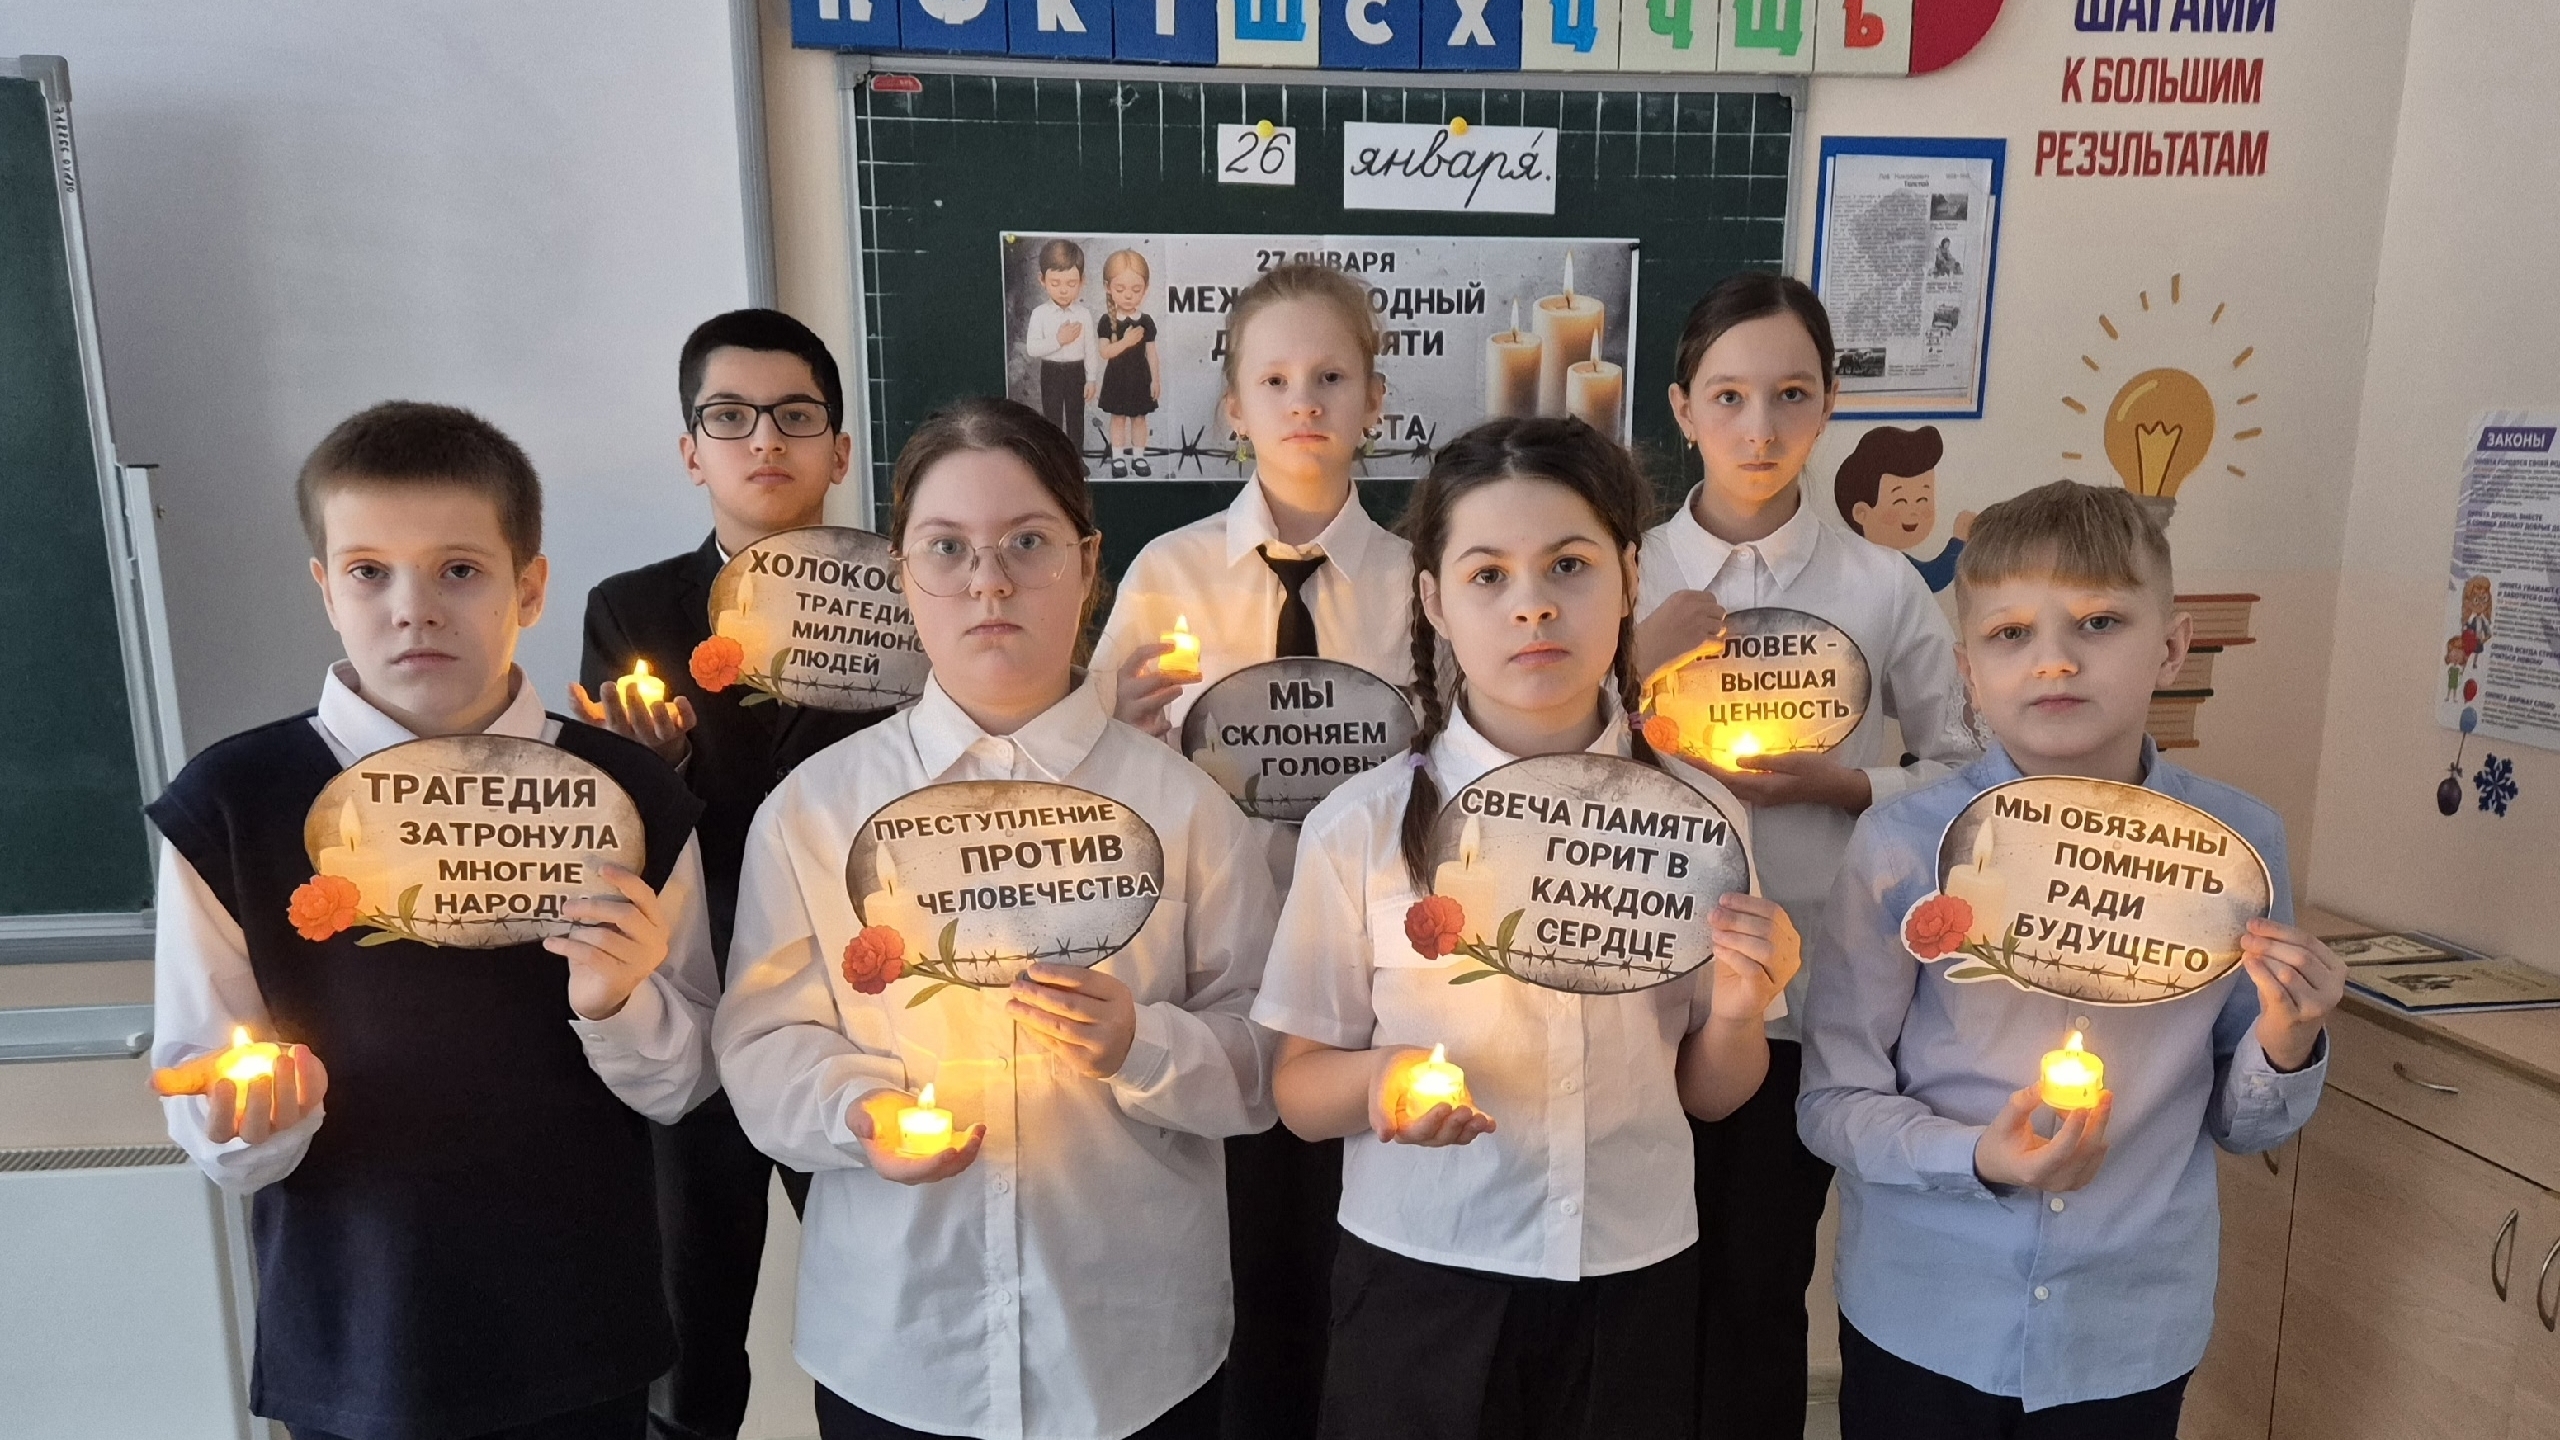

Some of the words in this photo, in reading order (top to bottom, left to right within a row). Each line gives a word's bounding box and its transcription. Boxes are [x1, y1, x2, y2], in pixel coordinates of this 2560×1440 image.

[2061, 56, 2086, 103] К
[2091, 56, 2264, 104] БОЛЬШИМ
[1225, 131, 1291, 174] 26
[2034, 130, 2269, 177] РЕЗУЛЬТАТАМ
[1256, 249, 1286, 273] 27
[1168, 280, 1486, 320] МЕЖОДНЫЙ
[2486, 431, 2547, 448] ЗАКОНЫ
[749, 549, 904, 595] ХОЛОКОС
[795, 591, 915, 626] ТРАГЕДИ
[791, 620, 926, 654] МИЛЛИОНО
[1696, 634, 1818, 662] ЛОВЕК
[790, 648, 880, 676] ЛЮДЕЙ
[1721, 668, 1836, 692] ВЫСШАЯ
[1269, 680, 1334, 711] МЫ
[1709, 699, 1850, 726] ЦЕННОСТЬ
[1221, 721, 1387, 746] СКЛОНЯЕМ
[361, 772, 597, 814] ТРАГЕДИЯ
[399, 821, 619, 850] ЗАТРОНУЛА
[874, 803, 1116, 842] ПРЕСТУПЛЕНИЕ
[1461, 787, 1571, 826] СВЕЧА
[1582, 802, 1727, 847] ПАМЯТИ
[1995, 794, 2052, 825] МЫ
[2060, 807, 2229, 857] ОБЯЗАНЫ
[438, 859, 584, 884] МНОГИЕ
[960, 834, 1124, 875] ПРОТИВ
[1546, 836, 1659, 875] ГОРИТ
[1666, 851, 1690, 879] В
[2054, 841, 2225, 895] ПОМНИТЬ
[434, 893, 588, 919] НАРОД
[917, 873, 1159, 915] ЧЕЛОВЕЧЕСТВА
[1531, 875, 1695, 921] КАЖДОМ
[2047, 879, 2146, 921] РАДИ
[1536, 918, 1677, 962] СЕРДЦЕ
[2014, 912, 2210, 973] БУДУЩЕГО
